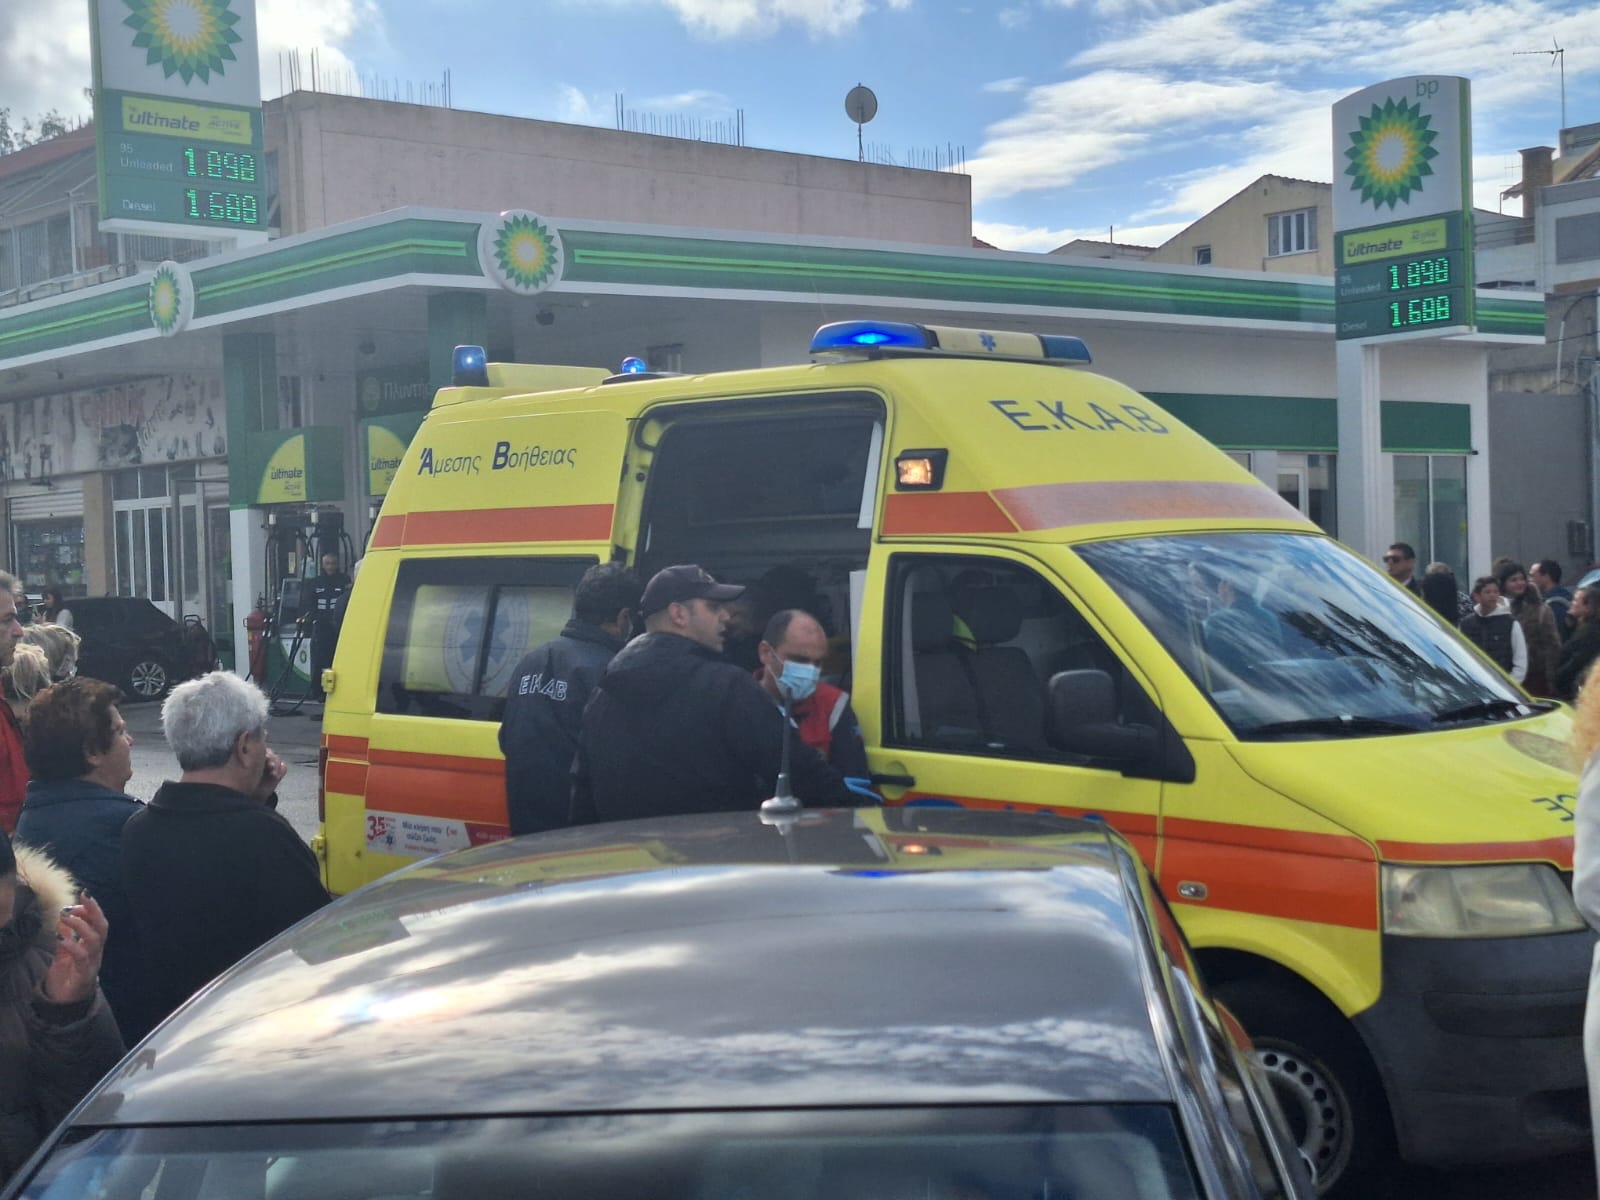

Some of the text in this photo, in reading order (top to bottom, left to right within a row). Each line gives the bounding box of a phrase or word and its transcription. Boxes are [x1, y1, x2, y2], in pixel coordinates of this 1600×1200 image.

[1416, 79, 1439, 98] bp
[129, 110, 200, 132] ultimate
[122, 199, 157, 212] Diesel
[187, 188, 258, 224] 1.688
[1347, 238, 1403, 257] ultimate
[1389, 258, 1449, 289] 1.898
[1390, 295, 1450, 327] 1.688
[417, 441, 577, 477] Άμεσης Βοήθειας
[271, 467, 303, 480] ultimate
